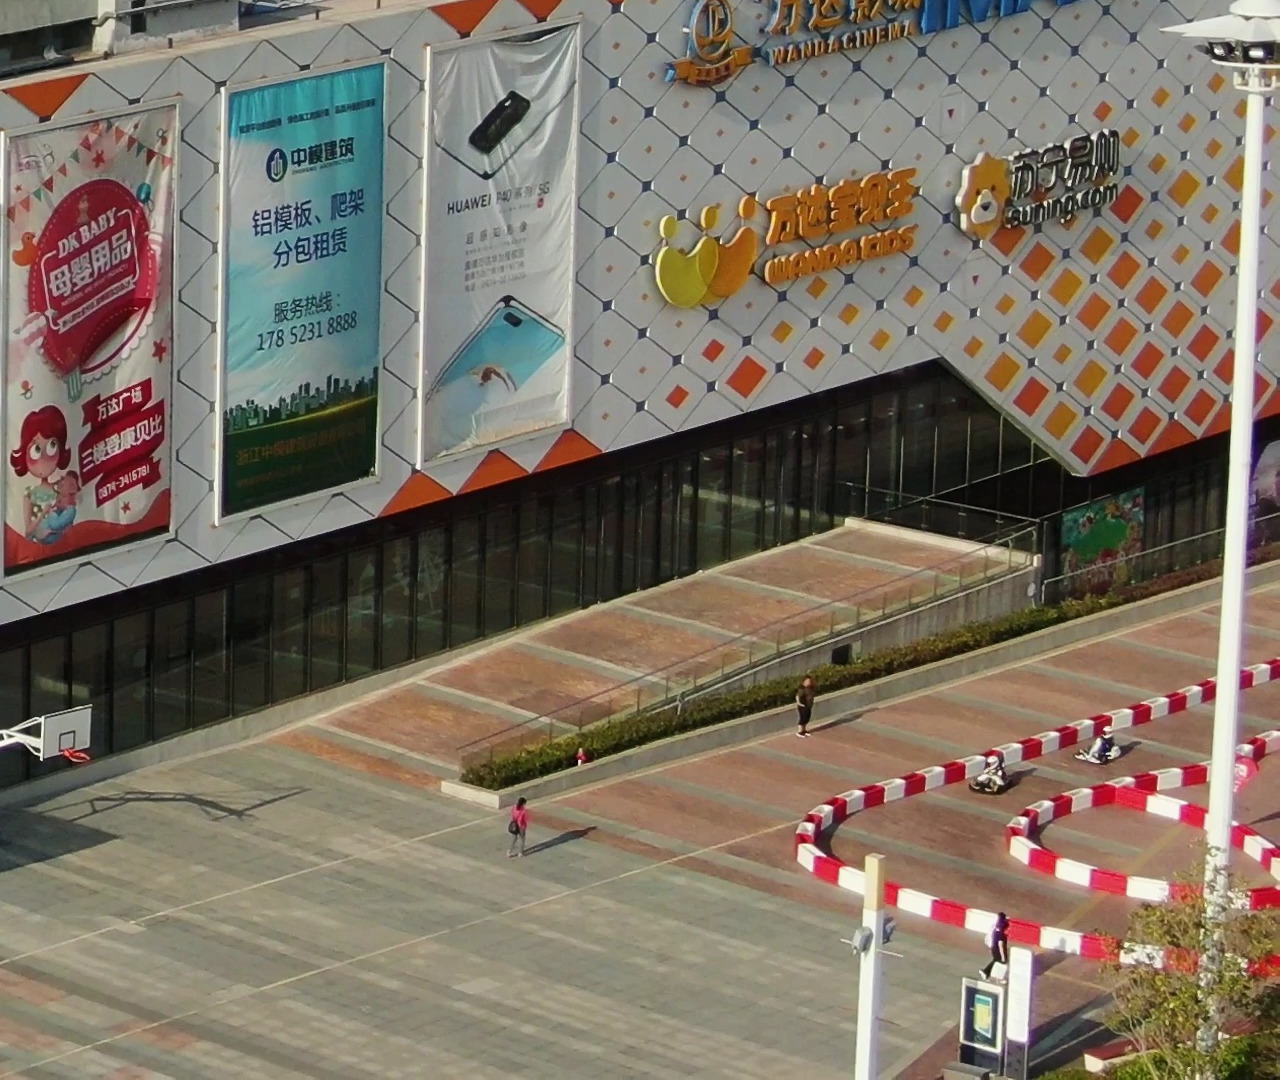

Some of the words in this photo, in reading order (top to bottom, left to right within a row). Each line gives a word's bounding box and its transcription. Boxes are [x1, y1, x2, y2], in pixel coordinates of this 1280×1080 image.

[768, 35, 841, 67] WANDA
[842, 20, 913, 50] CINEMA
[291, 137, 355, 167] 中模建筑
[1011, 129, 1119, 201] 苏宁易购
[447, 194, 491, 215] HUAWEI
[766, 167, 916, 246] 万达宝贝王
[58, 235, 79, 259] DK
[79, 207, 117, 241] BABY
[273, 227, 348, 269] 分包租赁
[765, 239, 857, 285] WANDA
[860, 224, 919, 261] KIDS
[49, 229, 131, 297] 母婴用品
[257, 329, 285, 351] 178
[290, 321, 323, 345] 5231
[327, 311, 358, 336] 8888
[97, 386, 142, 421] 万达广场
